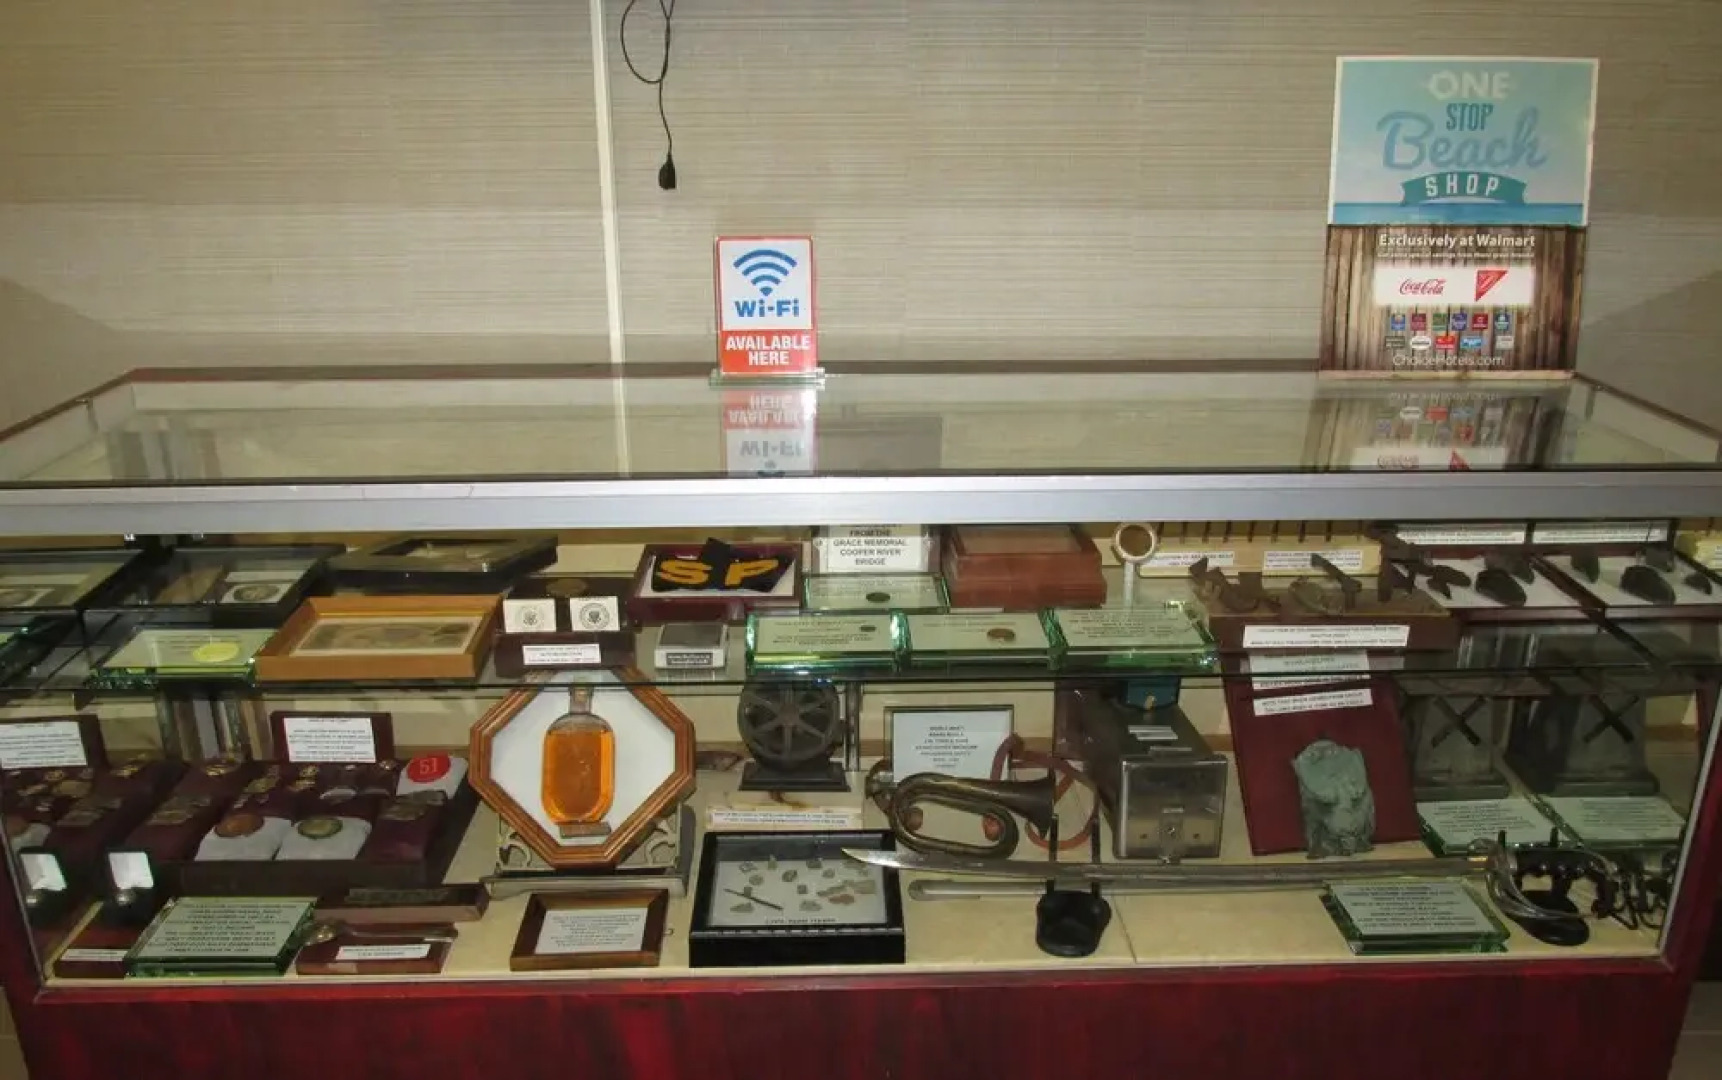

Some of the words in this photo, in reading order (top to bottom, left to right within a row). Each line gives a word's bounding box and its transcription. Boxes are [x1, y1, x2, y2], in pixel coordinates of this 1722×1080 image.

[1428, 70, 1510, 99] ONE
[1446, 102, 1494, 131] STOP
[1376, 105, 1548, 170] Beach
[1425, 174, 1500, 197] SHOP
[1379, 233, 1456, 248] Exclusively
[1459, 235, 1475, 247] at
[1476, 233, 1535, 247] Walmart
[734, 299, 799, 318] Wi-Fi
[726, 334, 811, 351] AVAILABLE
[748, 350, 790, 366] HERE
[1392, 354, 1506, 367] ChoiceHotels.com
